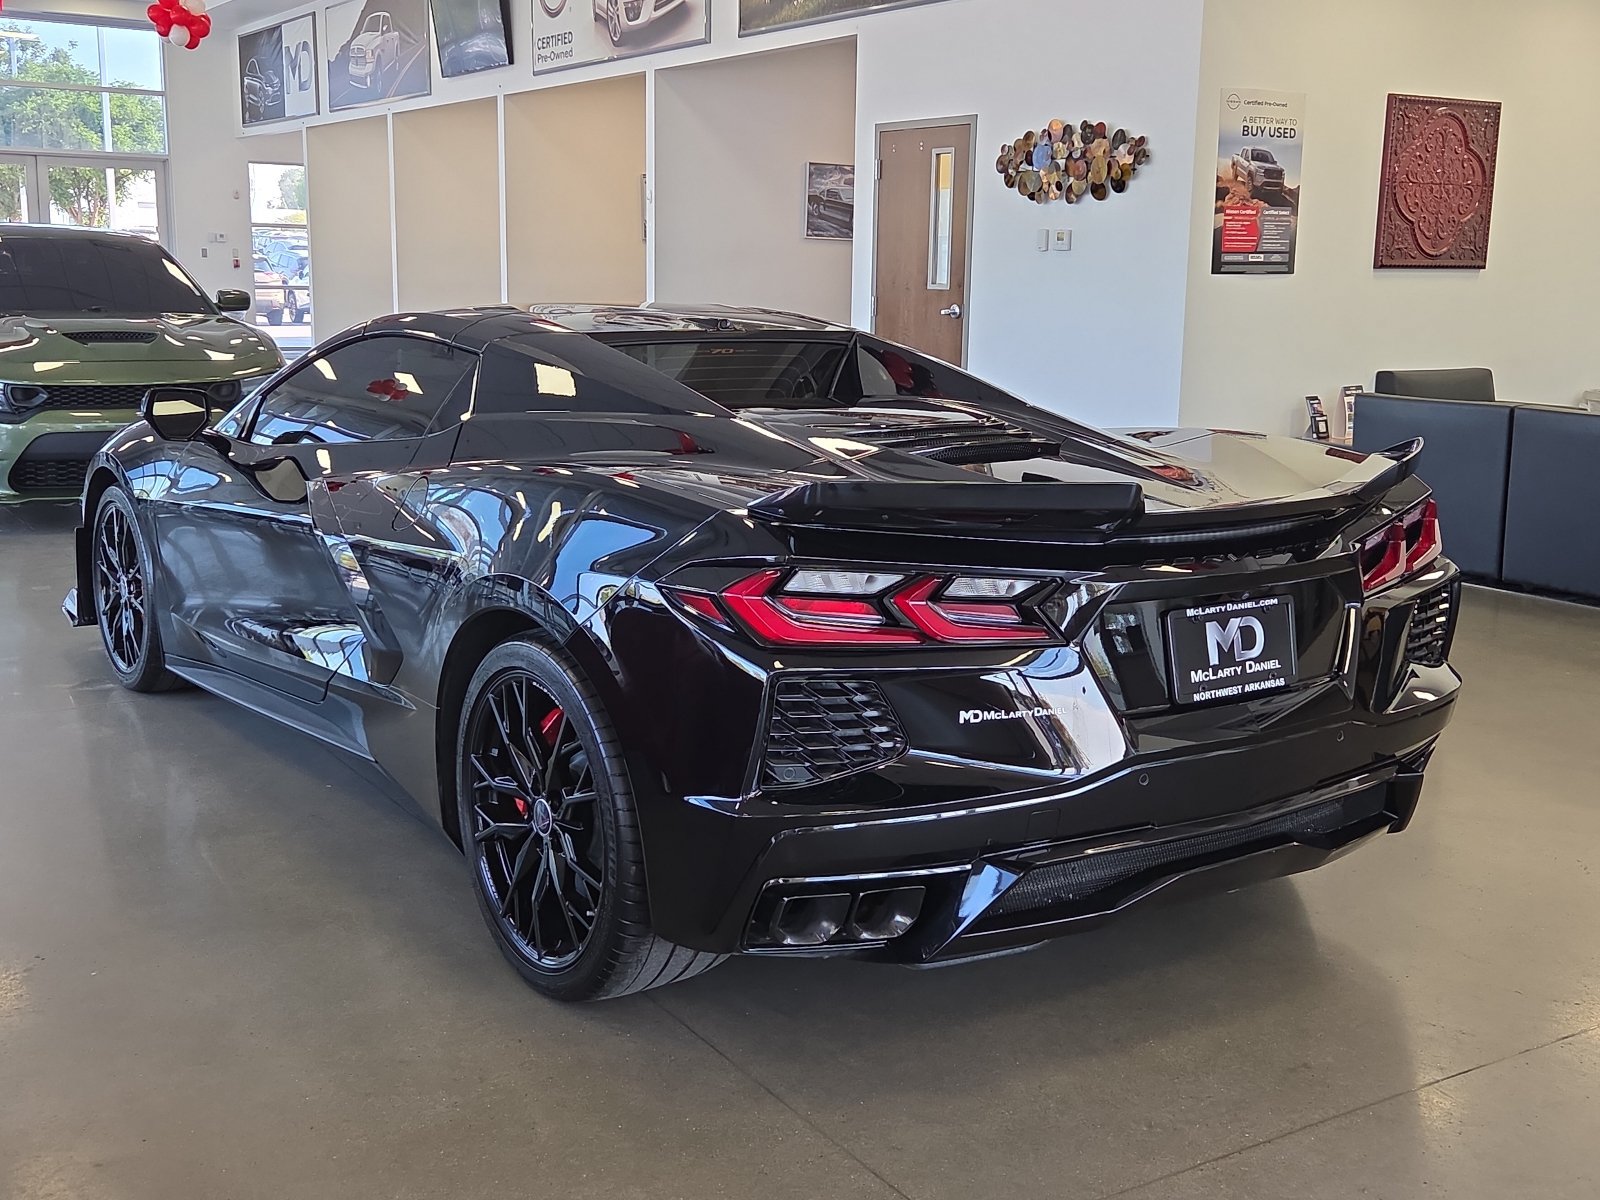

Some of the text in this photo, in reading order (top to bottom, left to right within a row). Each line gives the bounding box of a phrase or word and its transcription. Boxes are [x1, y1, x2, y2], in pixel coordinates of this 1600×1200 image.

[537, 31, 573, 50] CERTIFIED
[537, 46, 573, 64] Pre-Owned
[284, 40, 313, 95] MD
[1249, 116, 1275, 125] BETTER
[1275, 118, 1288, 126] WAY
[1289, 118, 1298, 126] TO
[1242, 125, 1297, 139] BUY USED
[1205, 616, 1265, 666] MD
[1190, 659, 1282, 683] McLARTY DANIEL
[1193, 678, 1285, 702] NORTHWEST ARKANSAS
[959, 709, 983, 724] MD
